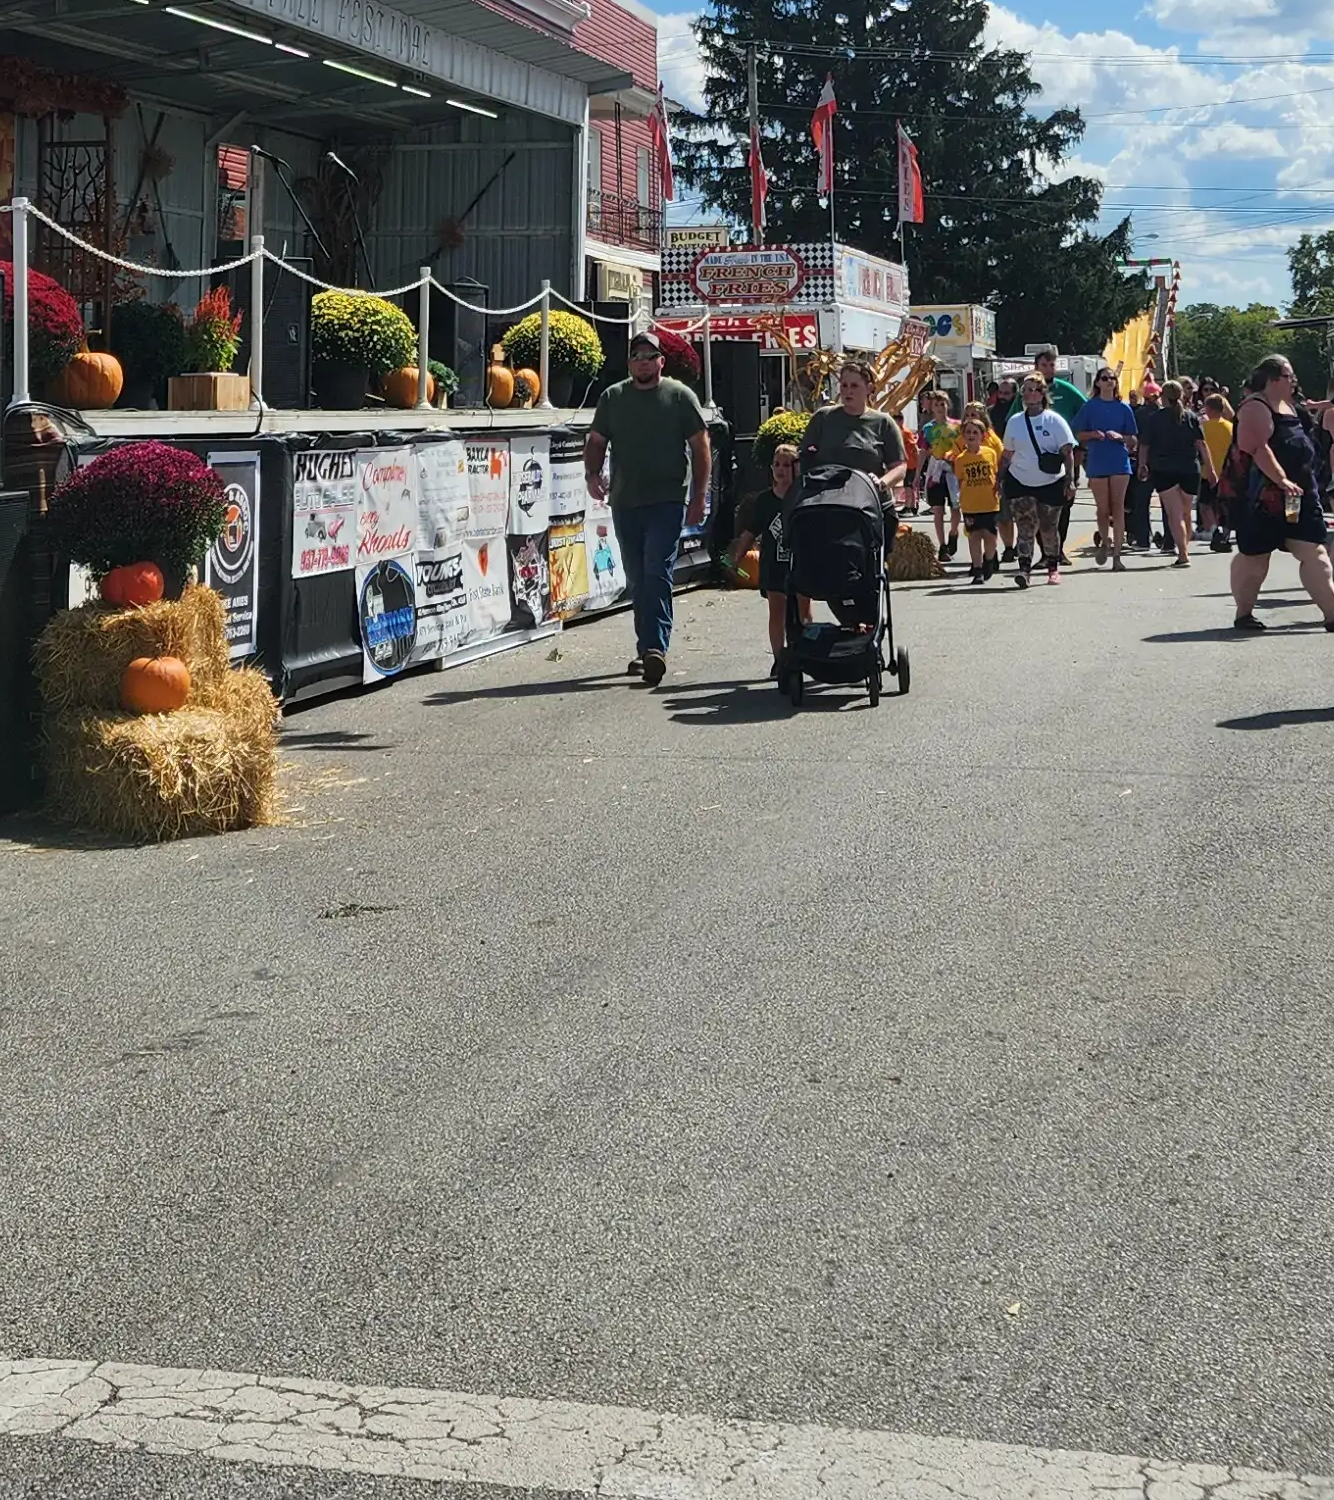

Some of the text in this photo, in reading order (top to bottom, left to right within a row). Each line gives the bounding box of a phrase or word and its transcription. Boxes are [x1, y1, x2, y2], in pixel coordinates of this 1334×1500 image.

[670, 231, 721, 243] BUDGET
[699, 264, 795, 281] FRENCH
[709, 281, 789, 297] FRIES
[751, 325, 817, 349] FRES
[295, 451, 356, 483] HUGHES
[465, 464, 489, 475] RACTOR
